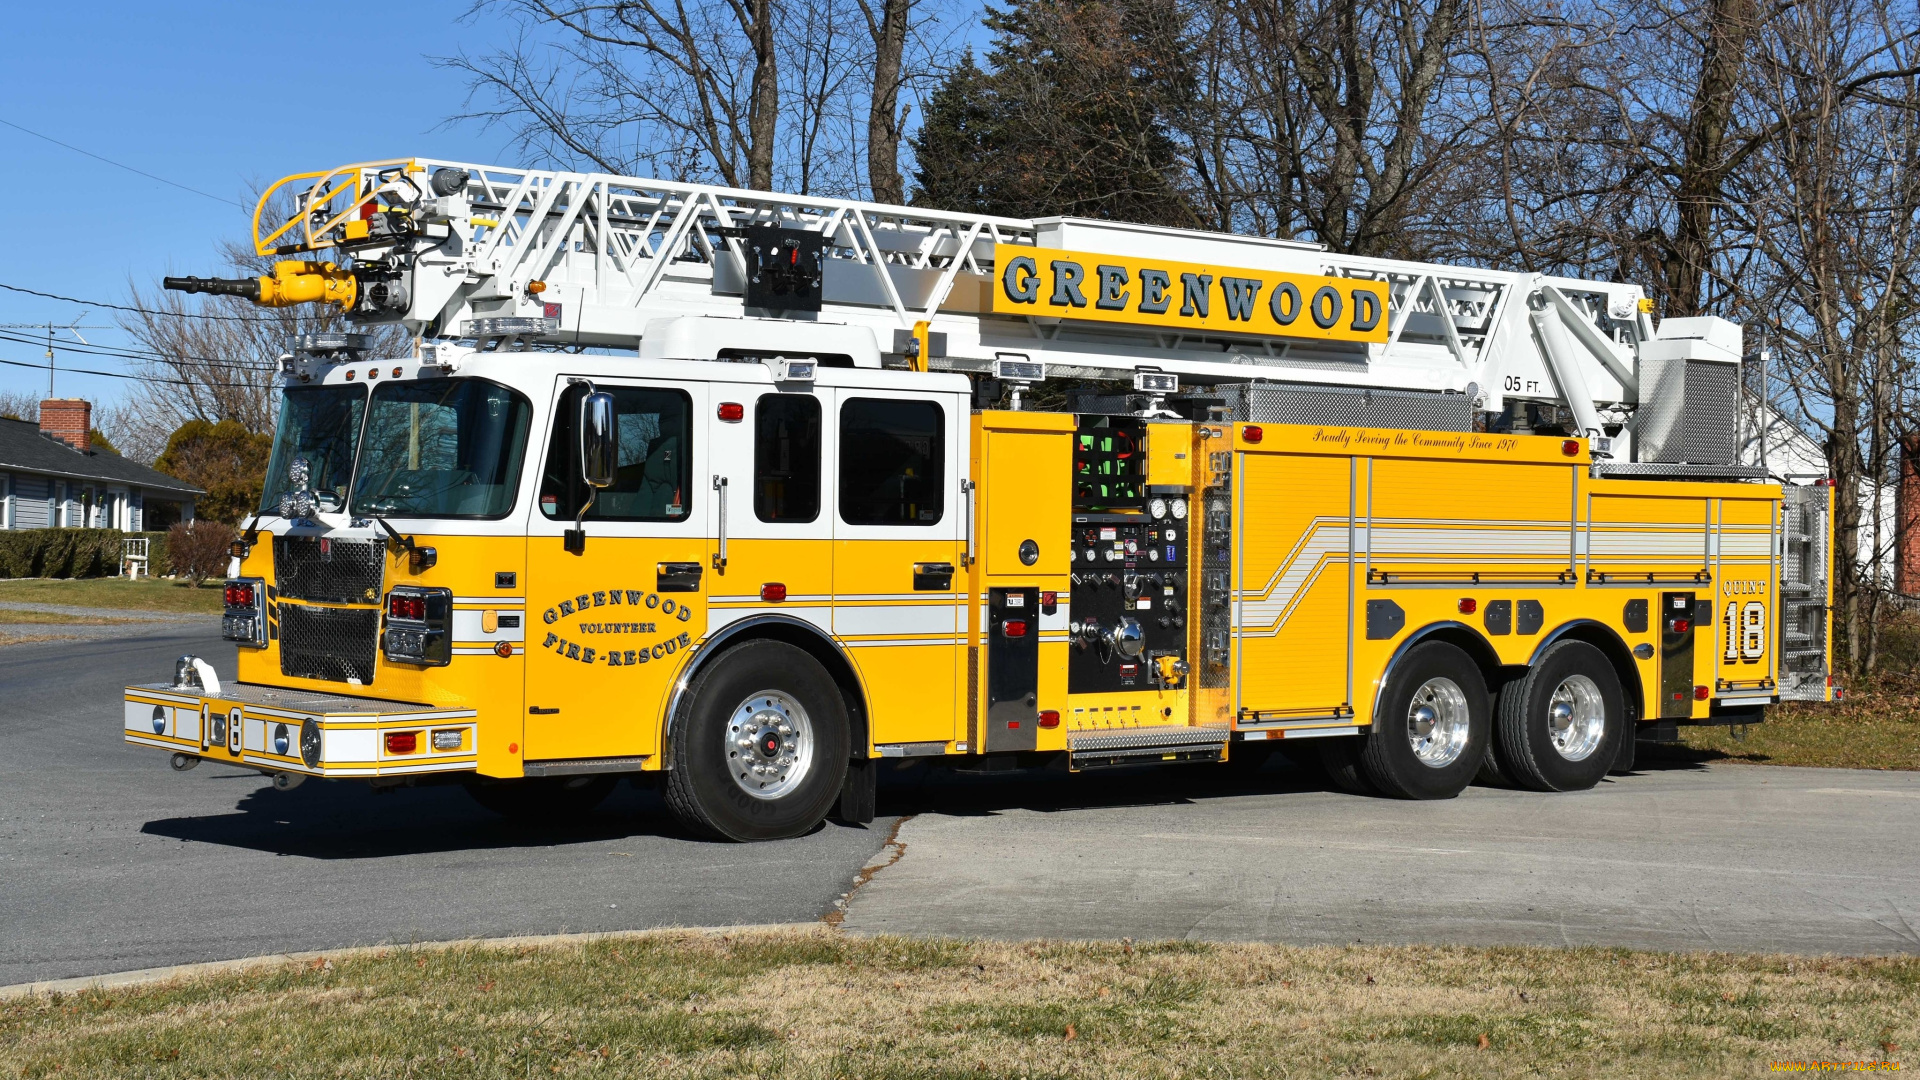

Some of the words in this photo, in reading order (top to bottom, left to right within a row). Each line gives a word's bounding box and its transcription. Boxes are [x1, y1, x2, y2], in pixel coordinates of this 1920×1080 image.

[1002, 255, 1382, 332] GREENWOOD
[1504, 375, 1521, 392] 05
[1526, 381, 1541, 393] FT.
[1312, 428, 1351, 448] Proudly
[1355, 430, 1390, 450] Serving
[1394, 432, 1409, 446] the
[1412, 432, 1465, 453] Community
[1469, 435, 1492, 450] Since
[1496, 438, 1519, 452] 1970
[1723, 580, 1766, 598] QUINT
[543, 589, 692, 624] GREENWOOD
[579, 622, 656, 634] VOLUNTEER
[1723, 601, 1765, 665] 18
